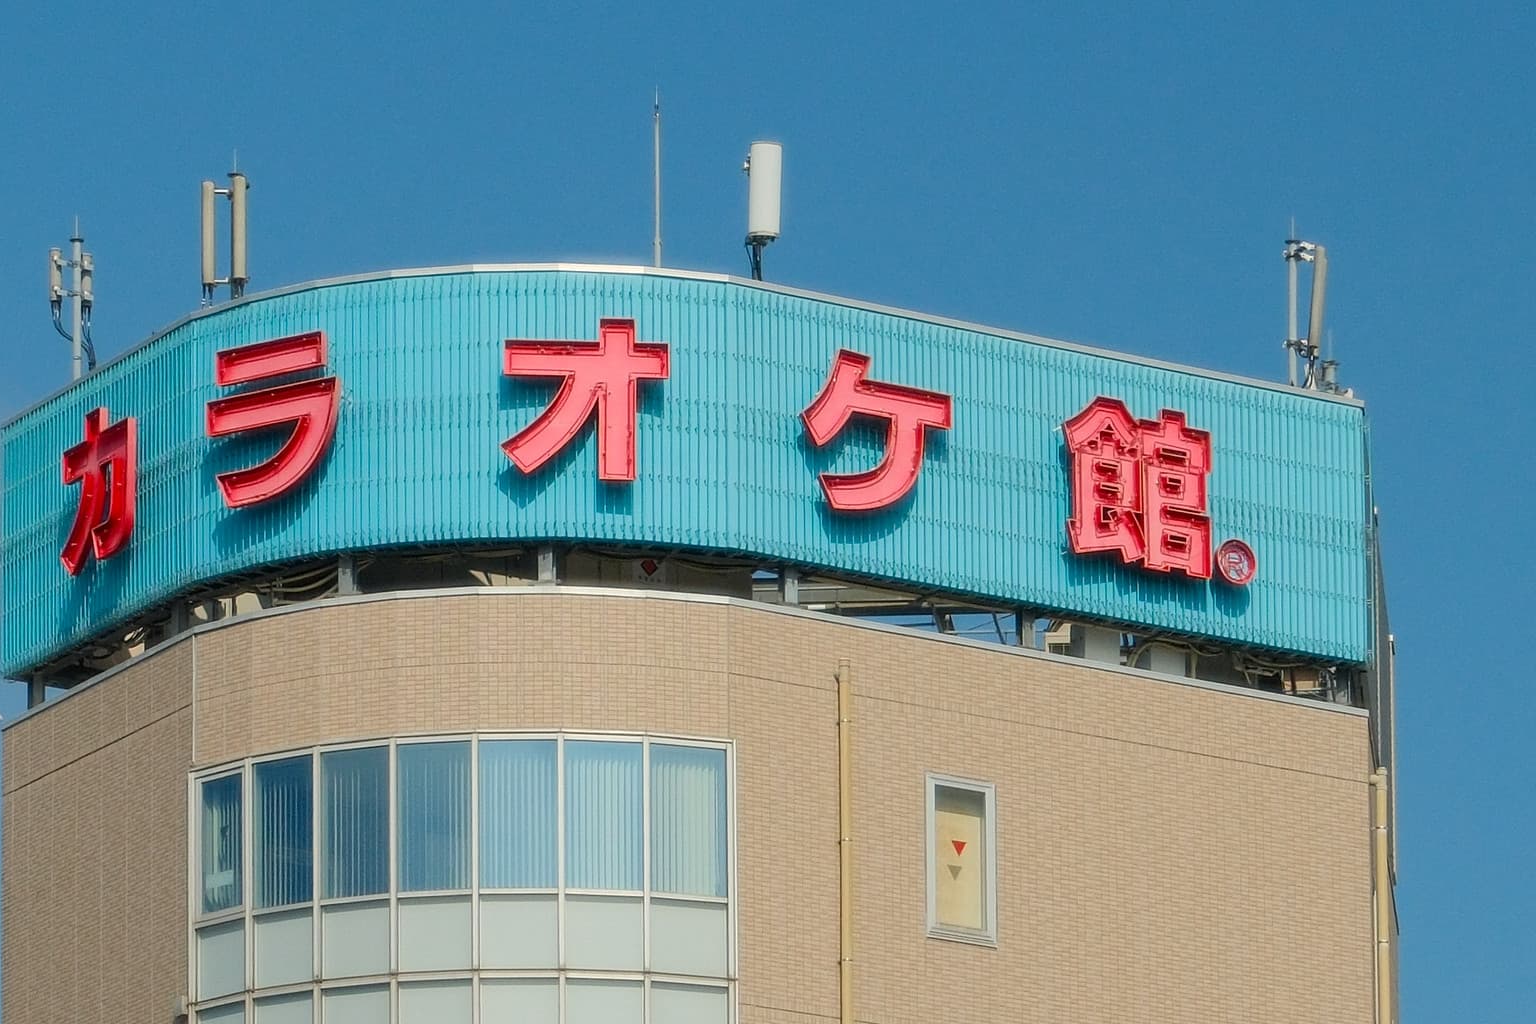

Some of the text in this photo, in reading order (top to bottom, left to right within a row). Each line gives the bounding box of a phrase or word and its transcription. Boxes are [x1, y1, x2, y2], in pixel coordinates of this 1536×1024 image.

[59, 317, 1212, 580] カラオケ館
